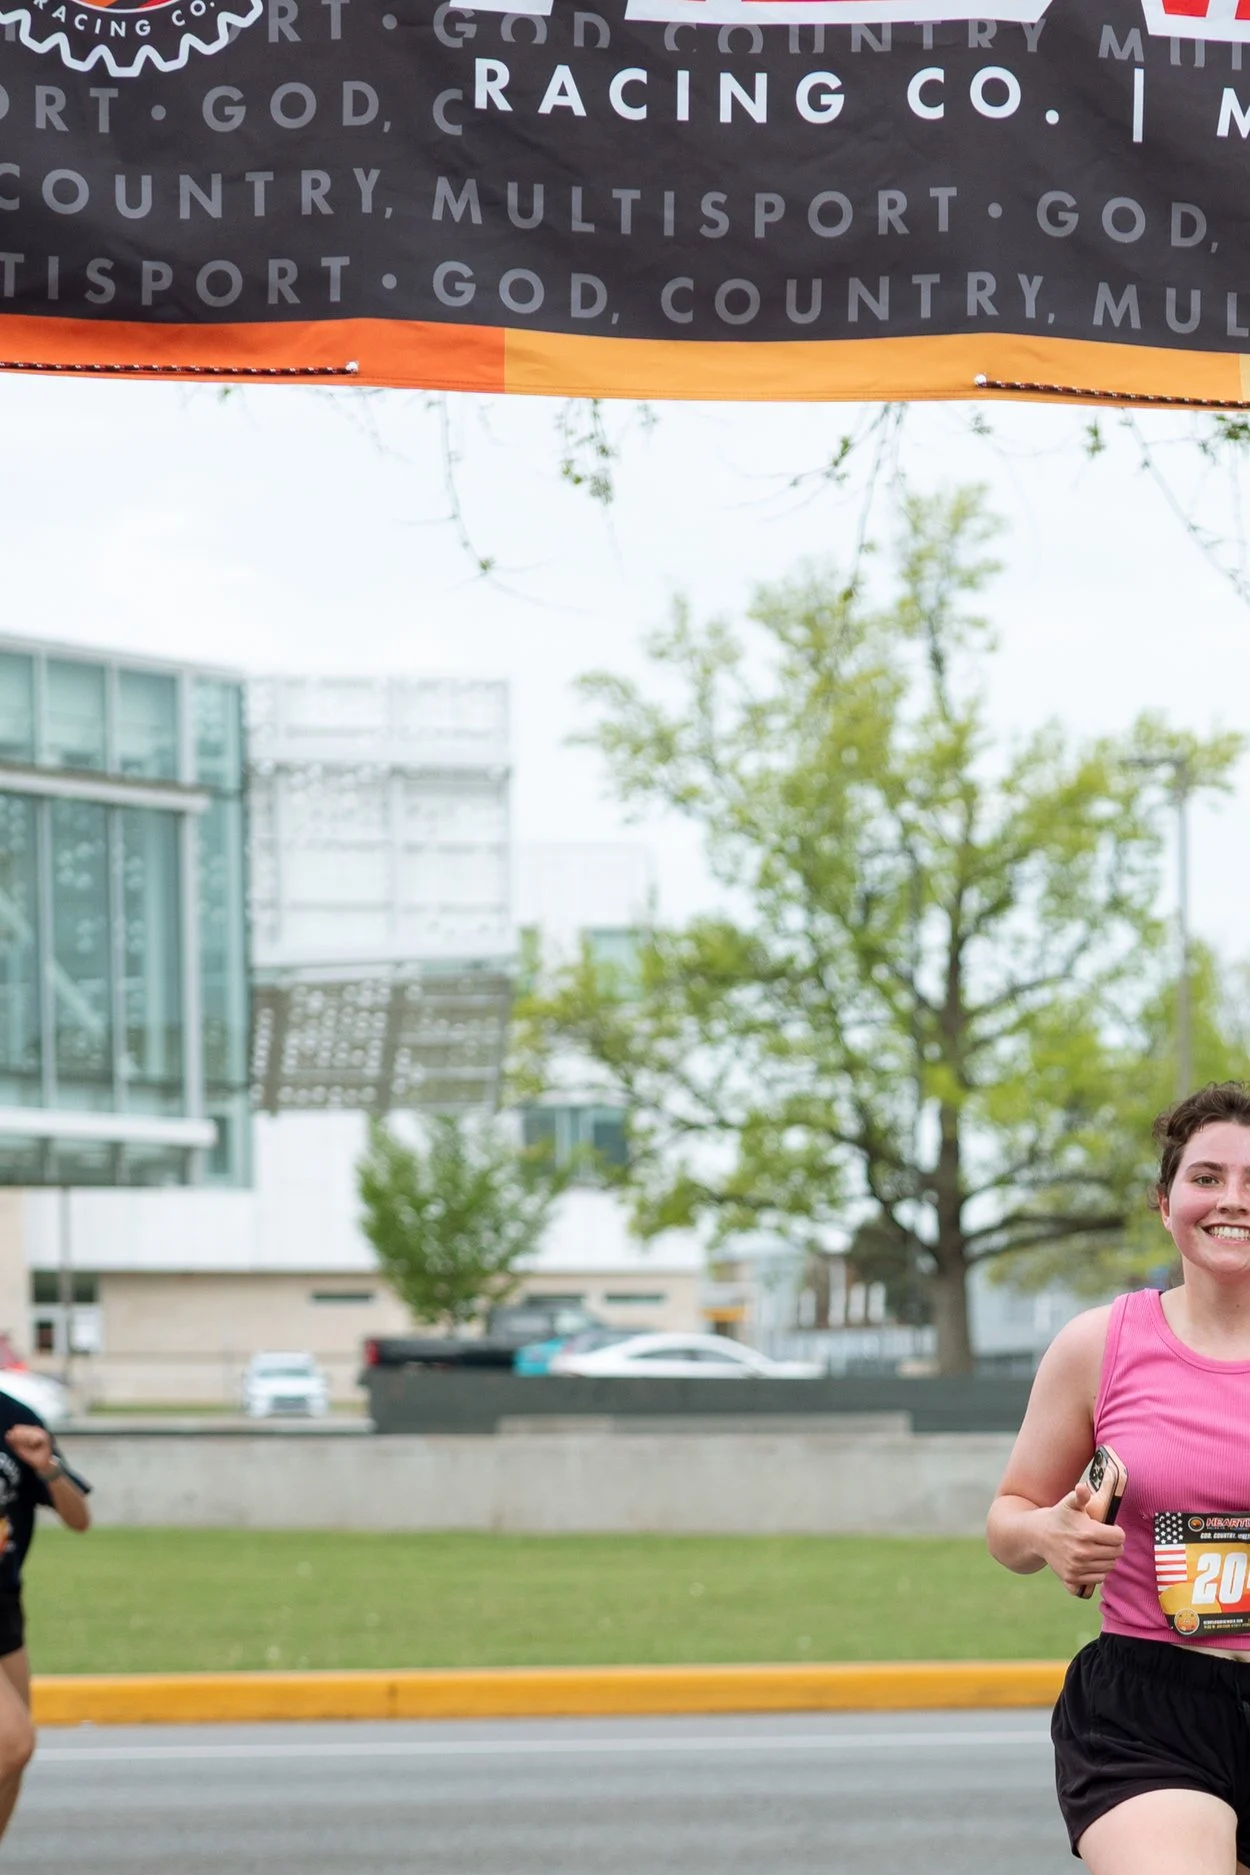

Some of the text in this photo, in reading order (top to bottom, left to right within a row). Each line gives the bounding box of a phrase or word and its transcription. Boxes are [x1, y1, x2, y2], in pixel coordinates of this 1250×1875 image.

[172, 0, 215, 26] CO.
[0, 84, 118, 133] RT
[202, 81, 391, 133] GOD,
[474, 57, 845, 124] RACING
[906, 66, 1060, 126] CO.
[431, 176, 958, 238] MULTISPORT
[1036, 190, 1218, 253] GOD,
[432, 260, 619, 324] GOD,
[661, 271, 1056, 325] COUNTRY,
